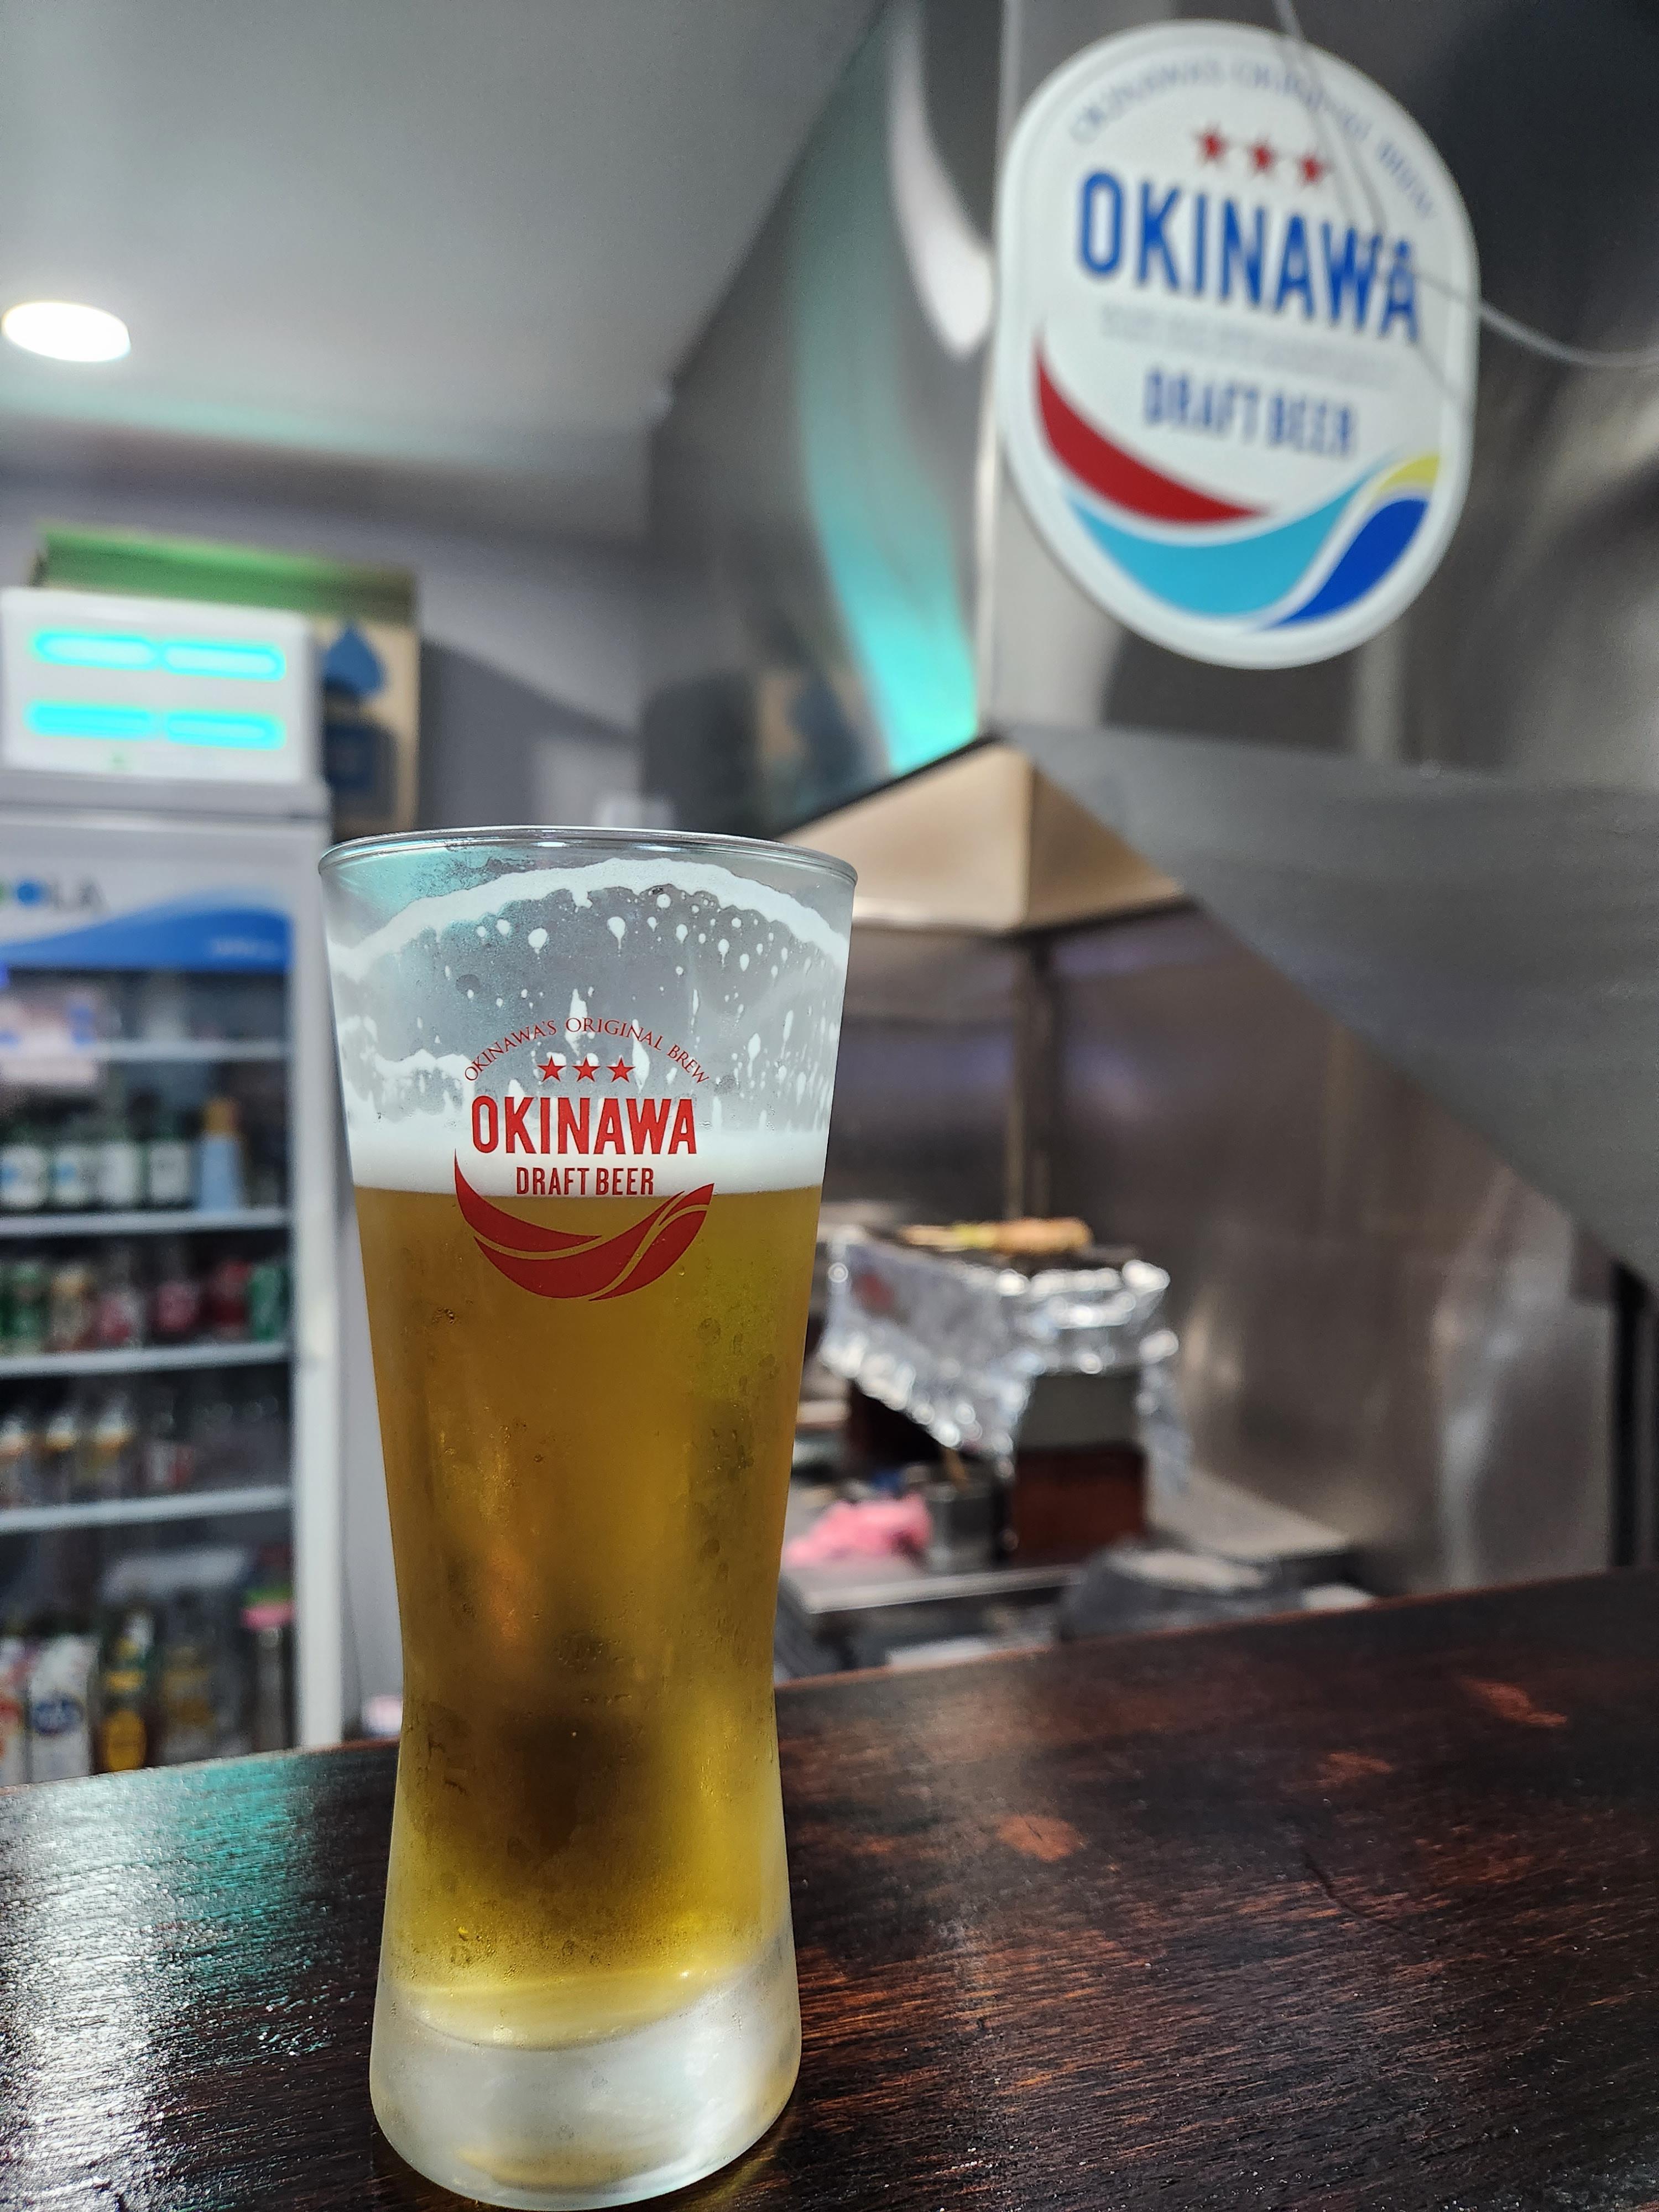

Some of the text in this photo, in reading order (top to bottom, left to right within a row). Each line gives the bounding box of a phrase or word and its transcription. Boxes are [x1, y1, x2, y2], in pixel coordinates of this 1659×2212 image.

[1077, 171, 1419, 344] OKINAWA
[465, 1017, 709, 1084] OKINAWA'S ORIGINAL BREW
[472, 1095, 697, 1155] OKINAWA
[516, 1167, 654, 1196] DRAFT BEER
